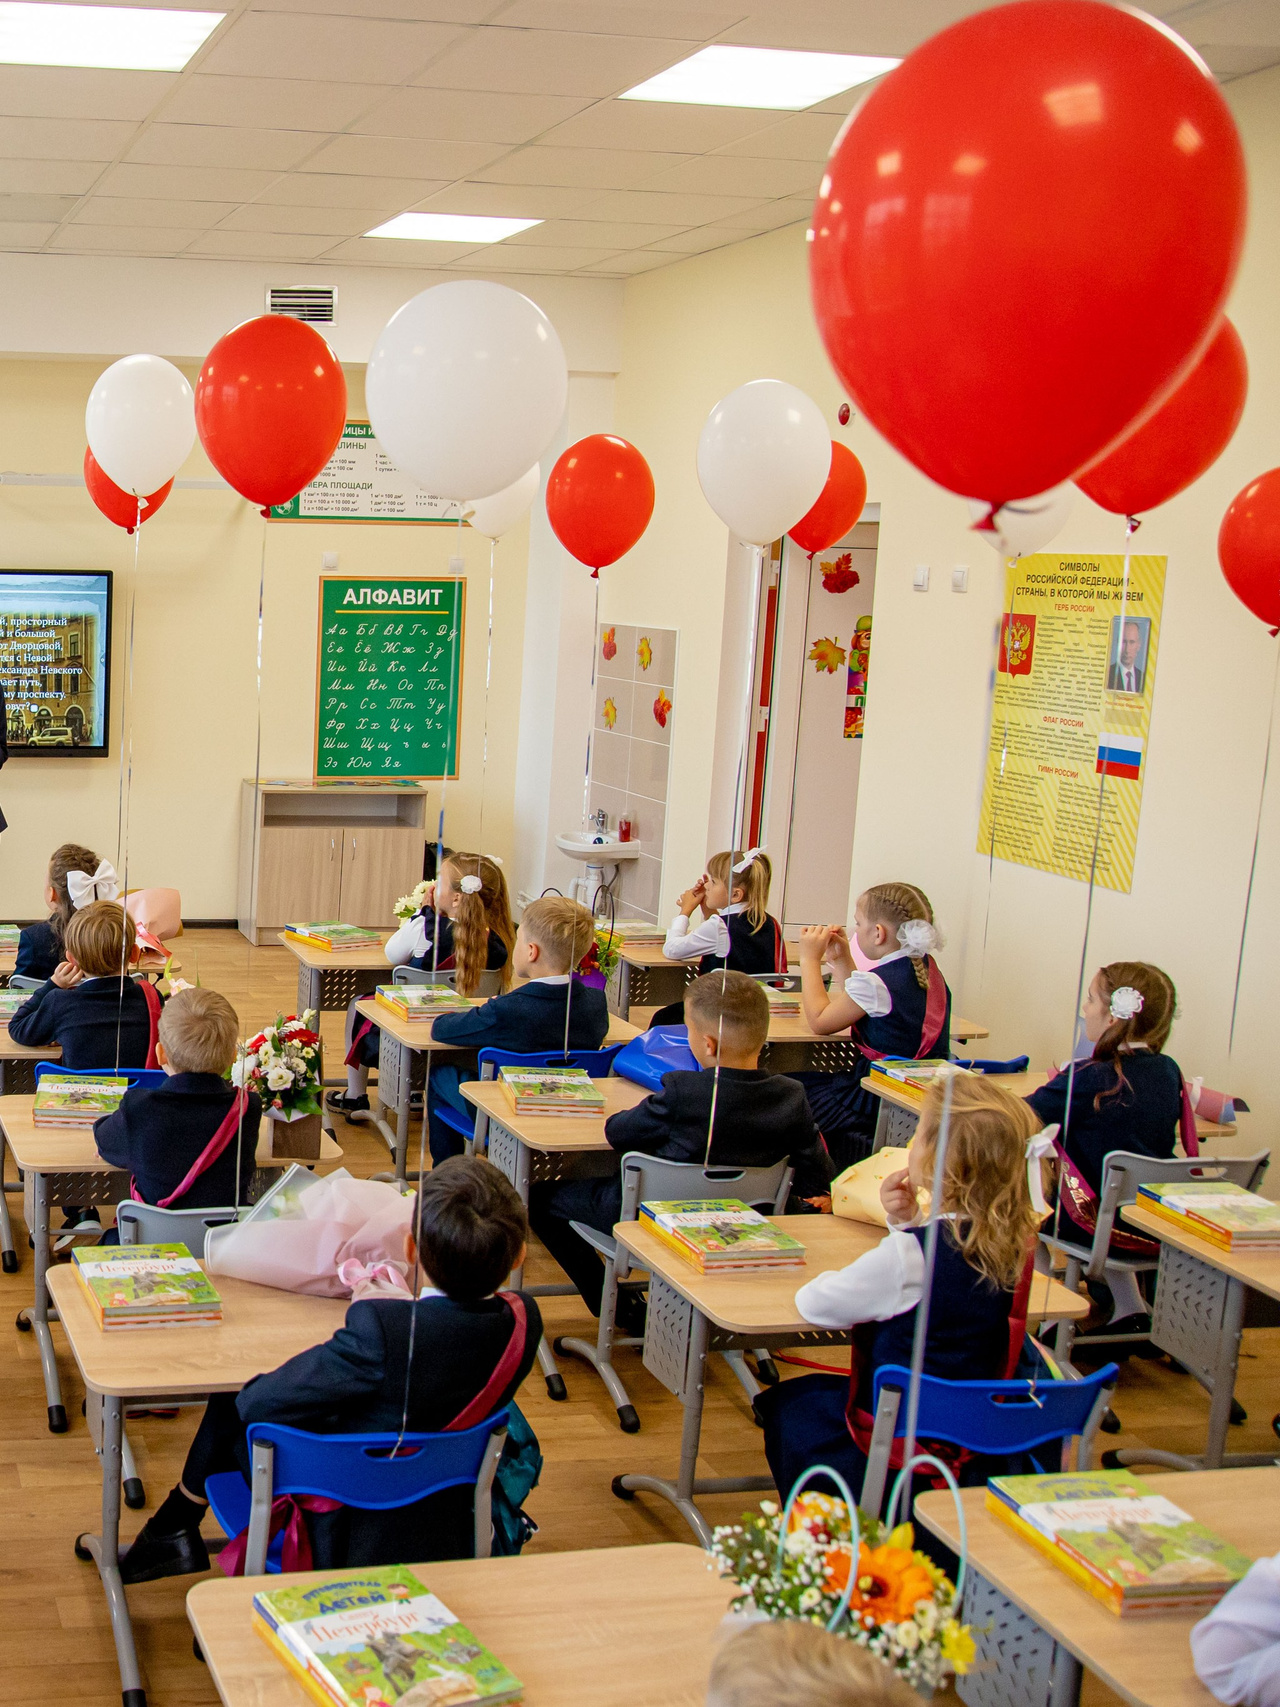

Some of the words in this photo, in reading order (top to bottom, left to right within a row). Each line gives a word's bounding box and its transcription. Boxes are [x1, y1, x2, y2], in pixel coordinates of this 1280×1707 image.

[344, 427, 366, 436] ИЦЫ
[330, 482, 373, 490] ПЛОЩАДИ
[1059, 561, 1100, 572] СИМВОЛЫ
[1026, 574, 1078, 585] РОССИЙСКОЙ
[342, 588, 444, 606] АЛФАВИТ
[1016, 586, 1048, 598] СТРАНЫ,
[1050, 588, 1056, 597] В
[1058, 588, 1095, 599] КОТОРОЙ
[1096, 591, 1110, 600] МЫ
[1054, 603, 1069, 611] ГЕРБ
[1070, 604, 1095, 612] РОССИИ
[10, 617, 68, 628] просторный
[15, 629, 56, 638] большой
[10, 641, 64, 651] Дворцовой,
[24, 653, 55, 662] Невой.
[40, 665, 83, 674] Невского
[17, 692, 66, 701] проспекту.
[5, 702, 30, 712] овут?
[1043, 715, 1058, 724] ФЛАГ
[1060, 718, 1084, 728] РОССИИ
[1038, 764, 1053, 774] ГИМН
[1054, 768, 1079, 779] РОССИИ
